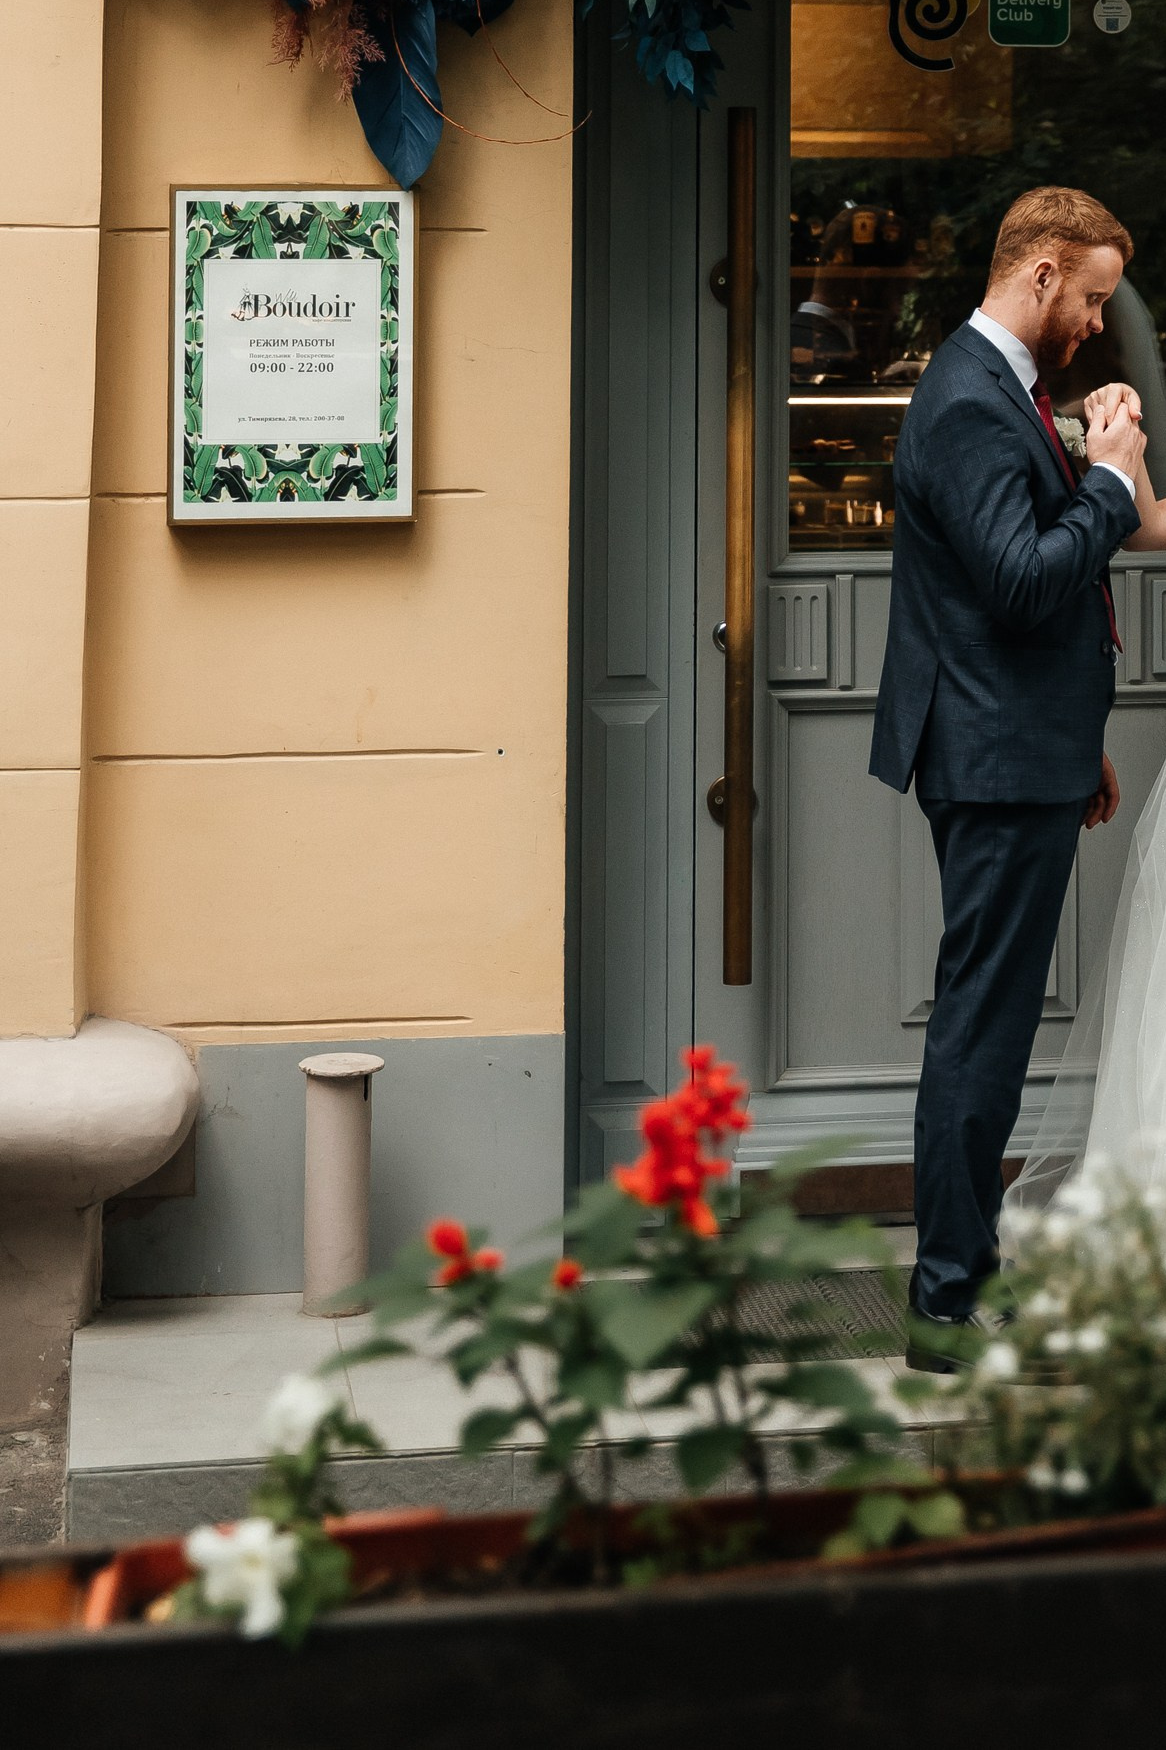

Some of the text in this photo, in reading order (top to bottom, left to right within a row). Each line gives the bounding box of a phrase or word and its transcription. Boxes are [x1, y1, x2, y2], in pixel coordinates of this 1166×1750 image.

[996, 8, 1033, 21] Club
[253, 293, 356, 318] Boudoir
[249, 338, 335, 348] РЕЖИМ РАБОТЫ
[295, 352, 335, 360] Воскресенье
[249, 362, 286, 373] 09:00
[297, 362, 334, 373] 22:00
